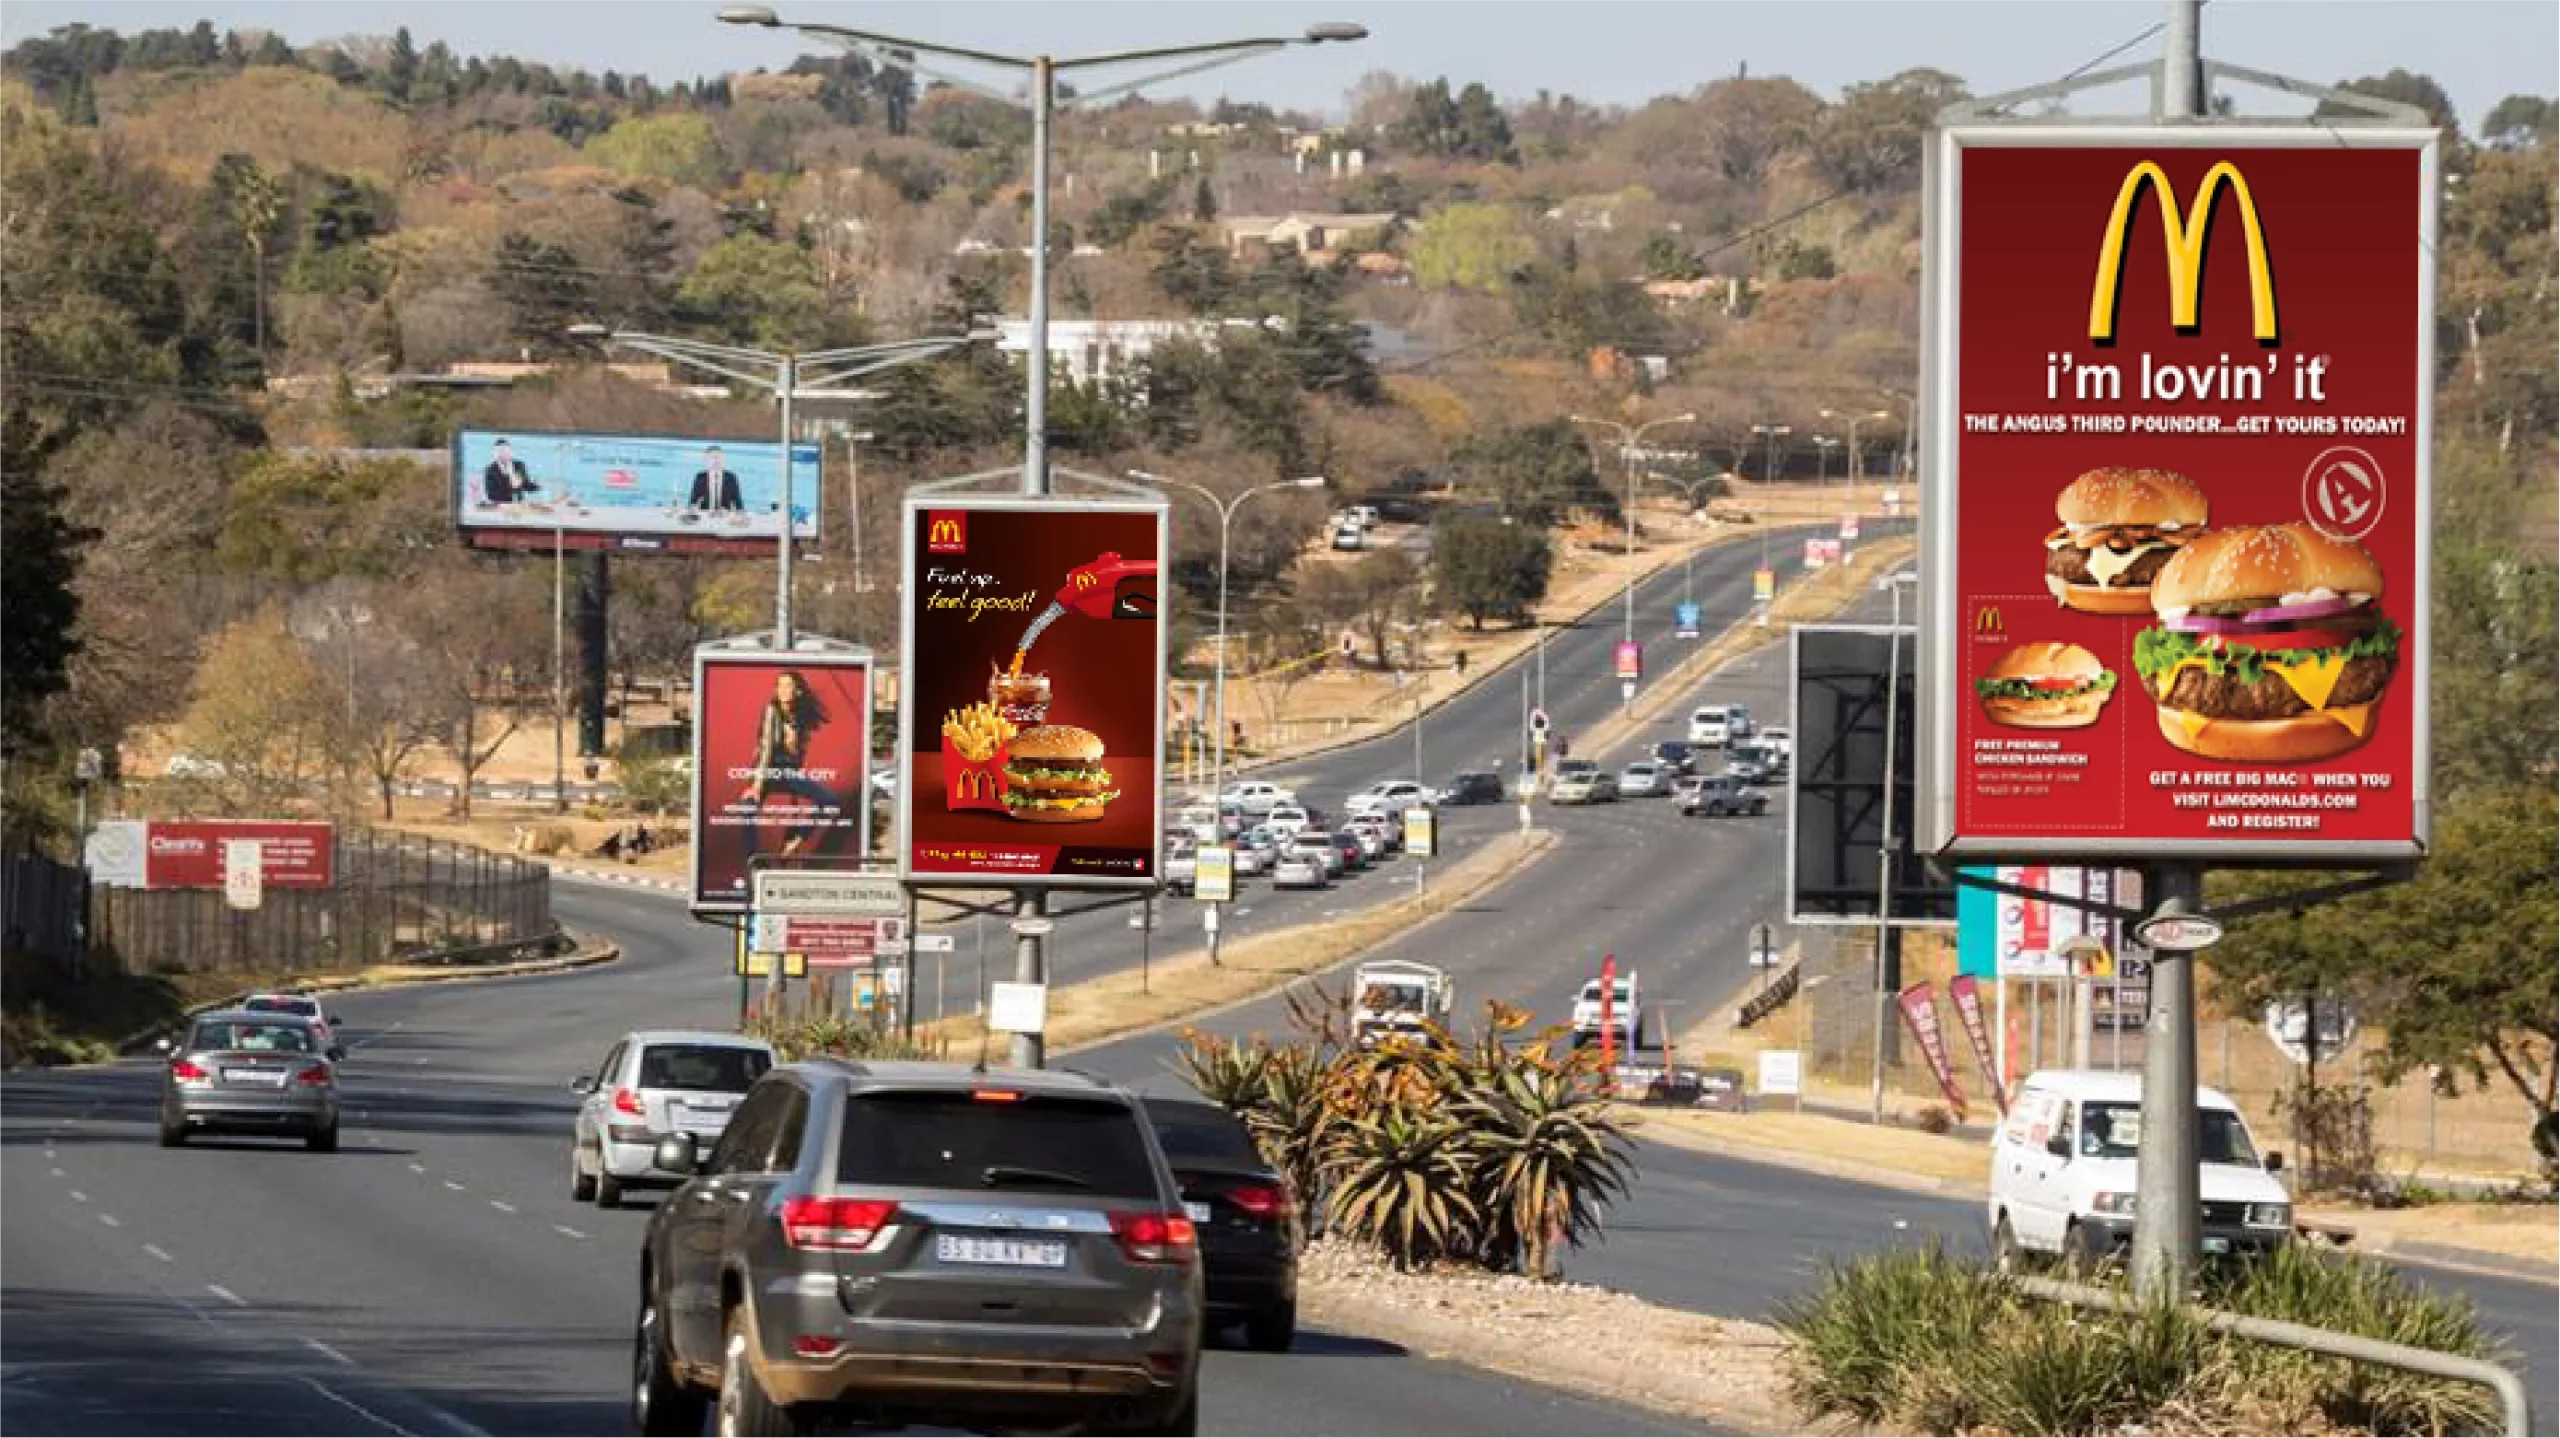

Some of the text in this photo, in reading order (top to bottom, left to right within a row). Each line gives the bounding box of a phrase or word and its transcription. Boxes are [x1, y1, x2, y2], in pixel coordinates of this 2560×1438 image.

[1964, 413, 1999, 433] THE
[2003, 414, 2067, 433] ANGUS
[2071, 414, 2126, 433] THIRD
[2275, 415, 2339, 434] YOURS
[2341, 415, 2406, 434] TODAY!
[727, 767, 764, 780] COM
[2150, 771, 2178, 786] GET
[2180, 771, 2192, 786] A
[2194, 771, 2232, 786] FREE
[2236, 771, 2262, 786] BIG
[2311, 773, 2358, 788] WHEN
[2360, 773, 2392, 788] YOU
[2173, 792, 2210, 807] VISIT
[2207, 813, 2321, 830] AND REGISTER!
